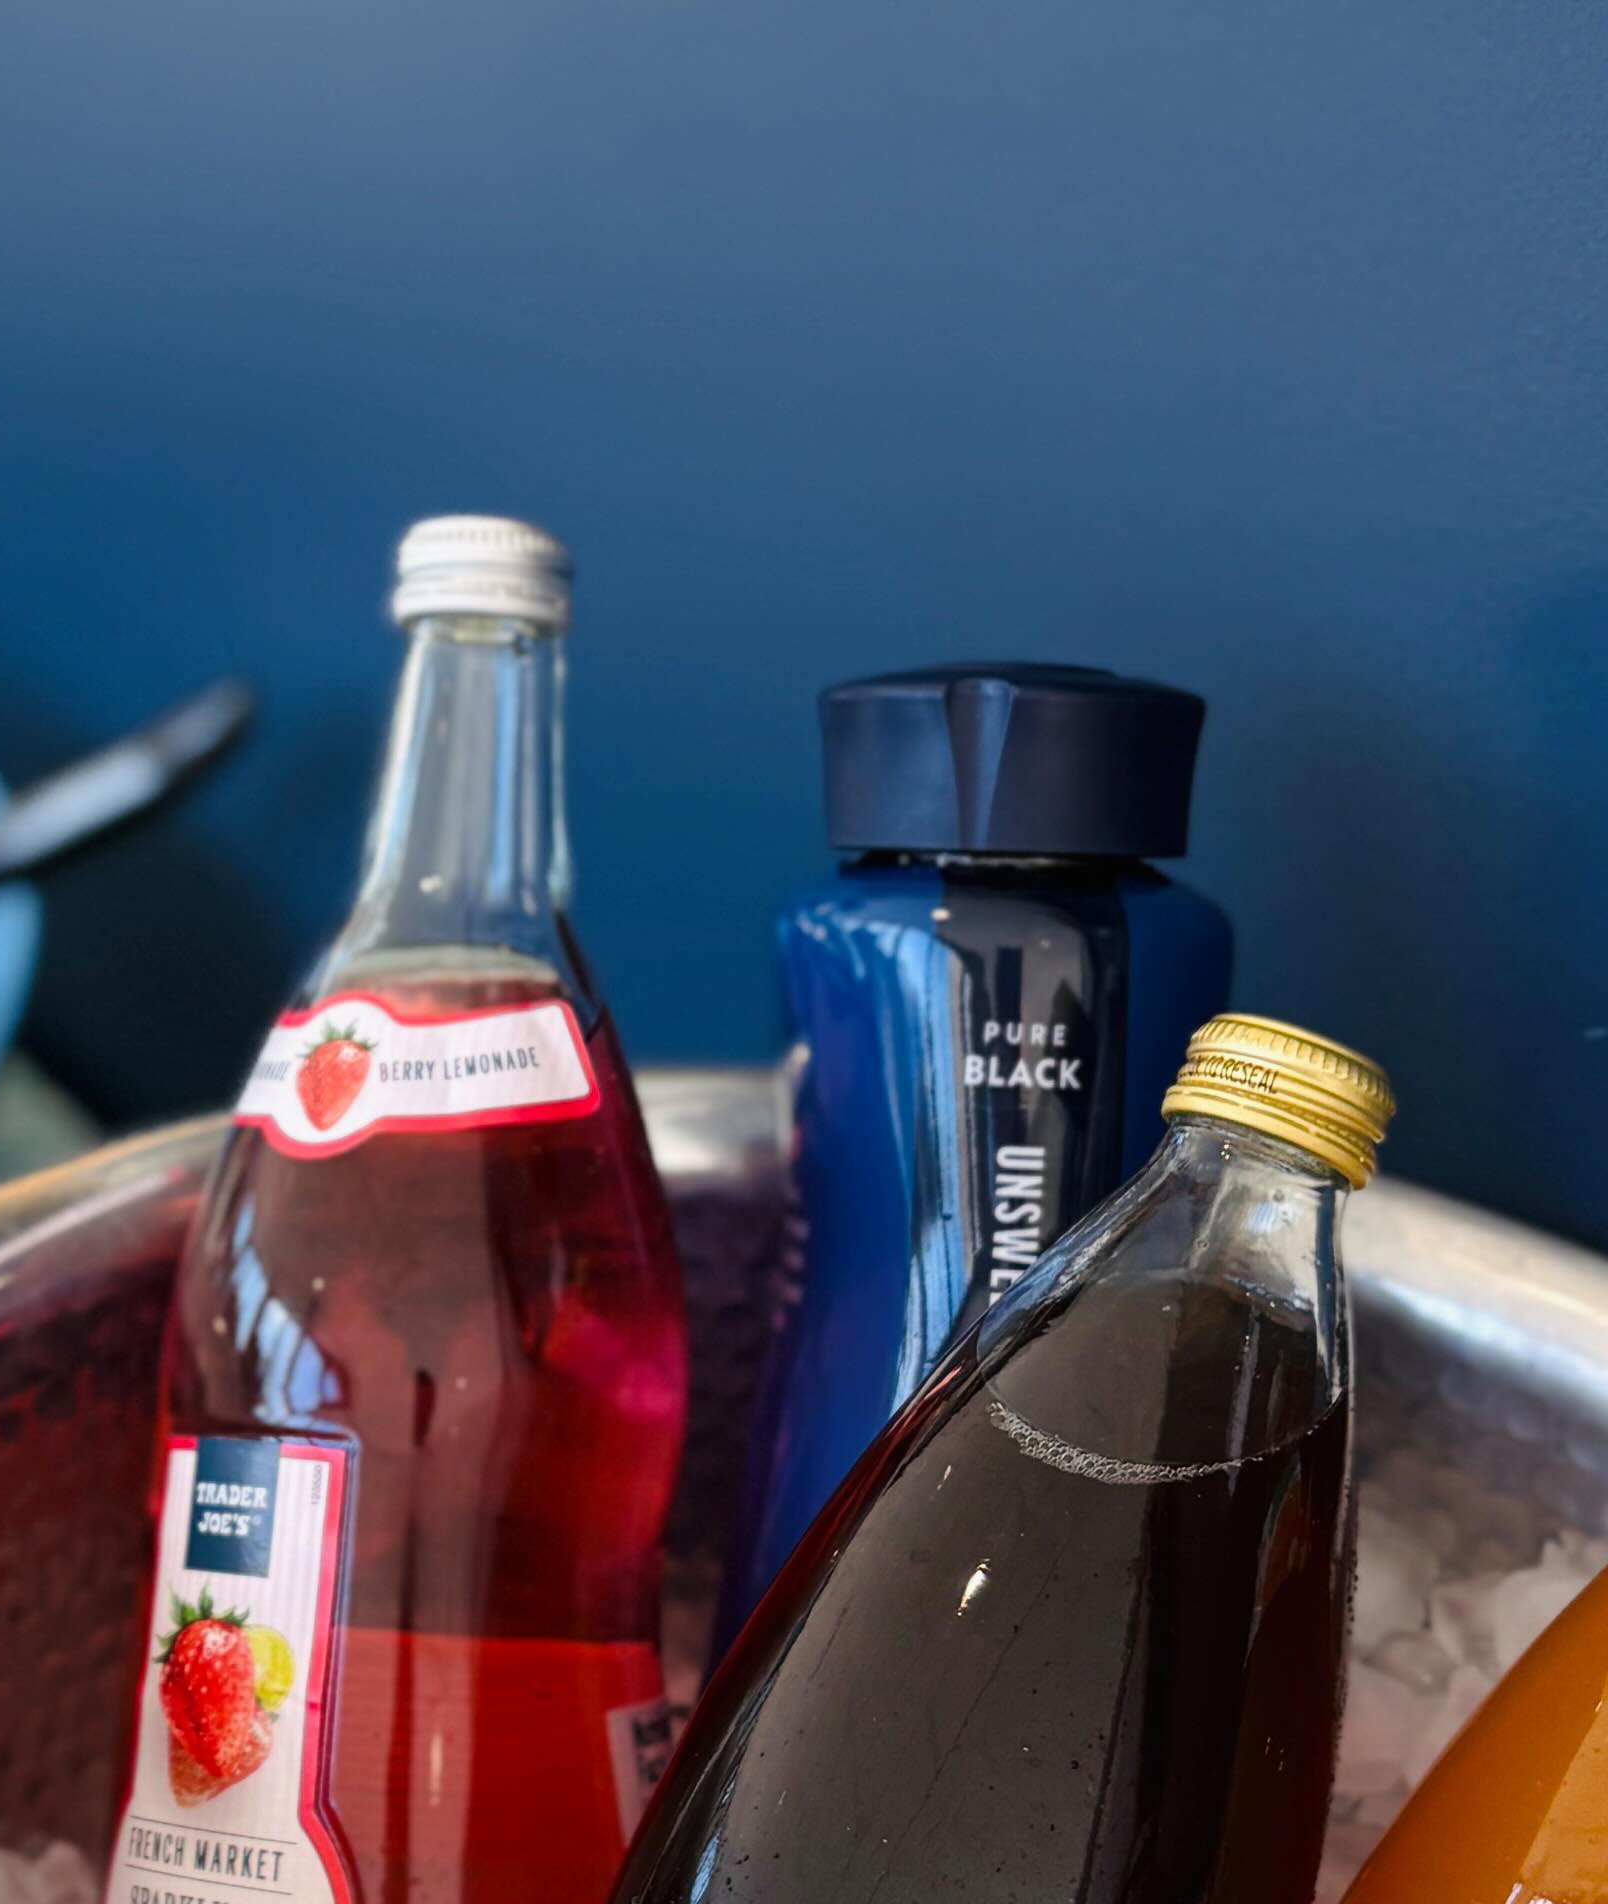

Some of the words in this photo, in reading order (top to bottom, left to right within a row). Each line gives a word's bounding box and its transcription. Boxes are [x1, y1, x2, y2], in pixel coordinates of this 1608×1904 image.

[983, 1022, 1067, 1046] PURE
[379, 1062, 435, 1083] BERRY
[444, 1047, 541, 1081] LEMONADE
[963, 1054, 1081, 1091] BLACK
[1219, 1058, 1281, 1094] RESEAL
[990, 1145, 1047, 1308] UNSWE
[196, 1482, 268, 1509] TRADER
[128, 1827, 186, 1866] FRENCH
[193, 1839, 284, 1881] MARKET
